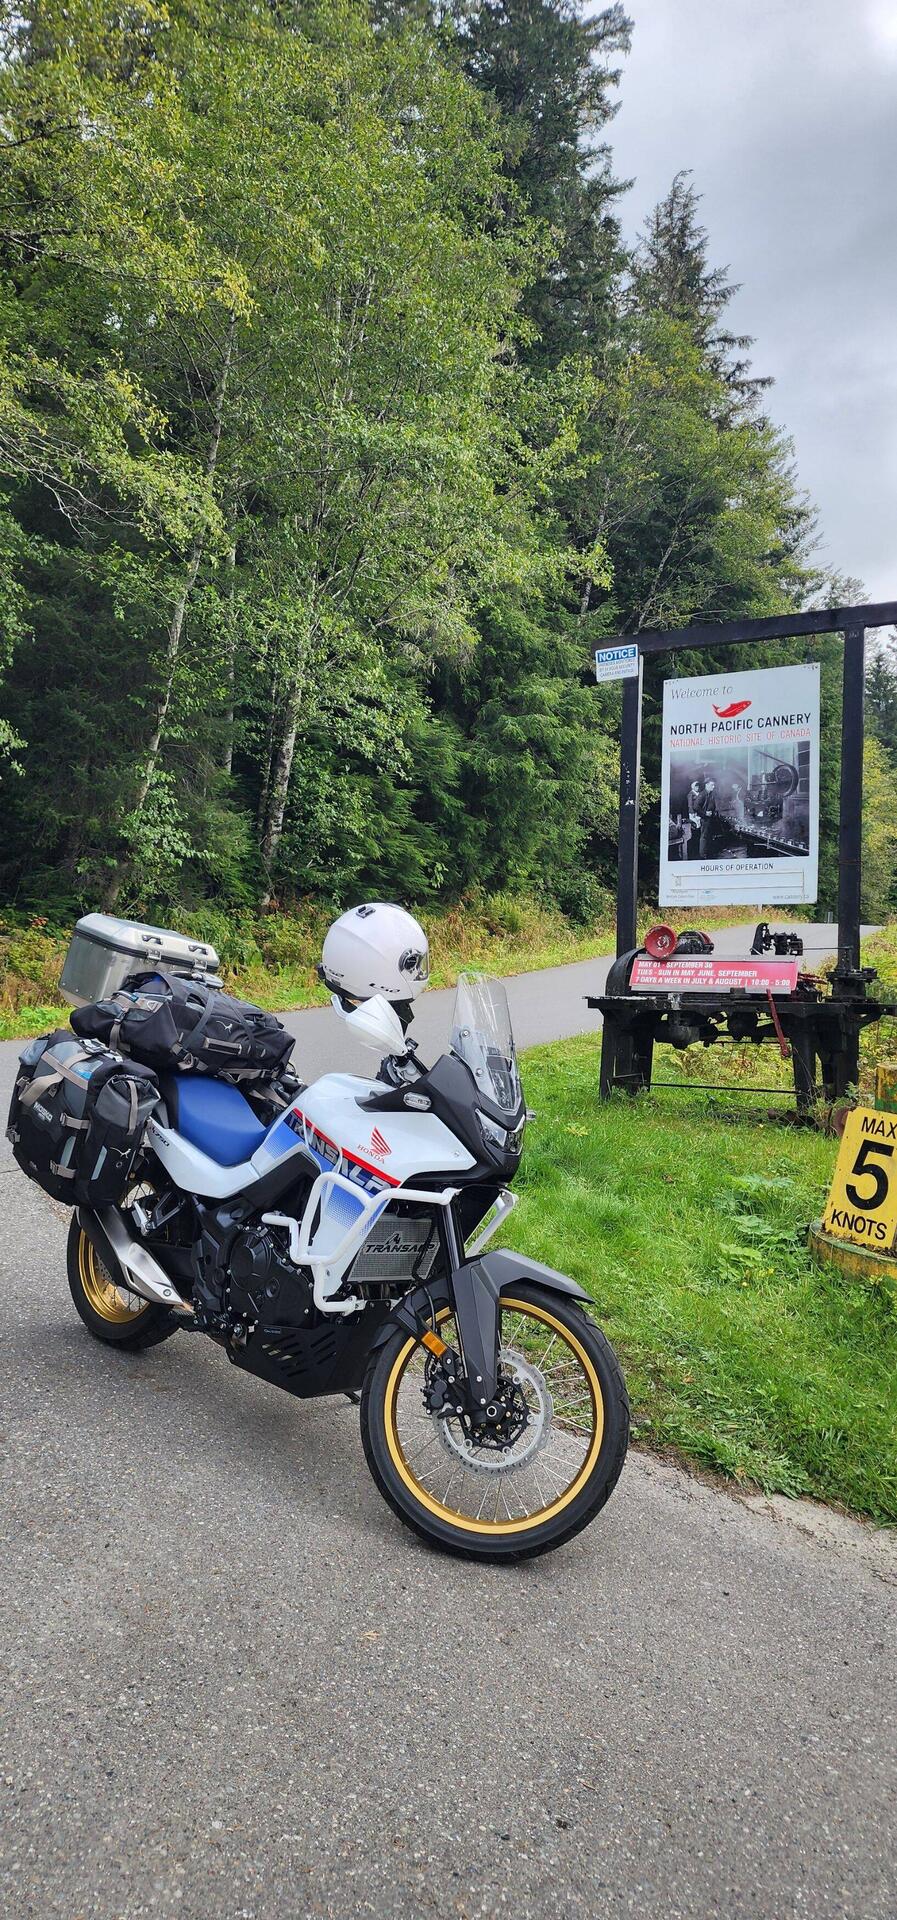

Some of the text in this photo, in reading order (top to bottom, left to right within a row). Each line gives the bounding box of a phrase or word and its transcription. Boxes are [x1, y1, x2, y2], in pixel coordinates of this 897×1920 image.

[599, 648, 635, 662] NOTICE
[671, 685, 733, 700] Welcome to
[670, 712, 812, 736] NORTH PACIFIC CANNERY
[670, 728, 811, 748] NATIONAL HISTORIC SITE OF CANADA
[700, 864, 724, 872] HOURS
[735, 863, 774, 871] OPERATION
[861, 1116, 897, 1140] MAX
[357, 1143, 385, 1165] HONDA
[845, 1138, 895, 1211] 5
[830, 1208, 888, 1241] KNOTS
[365, 1243, 435, 1253] TRANSAP
